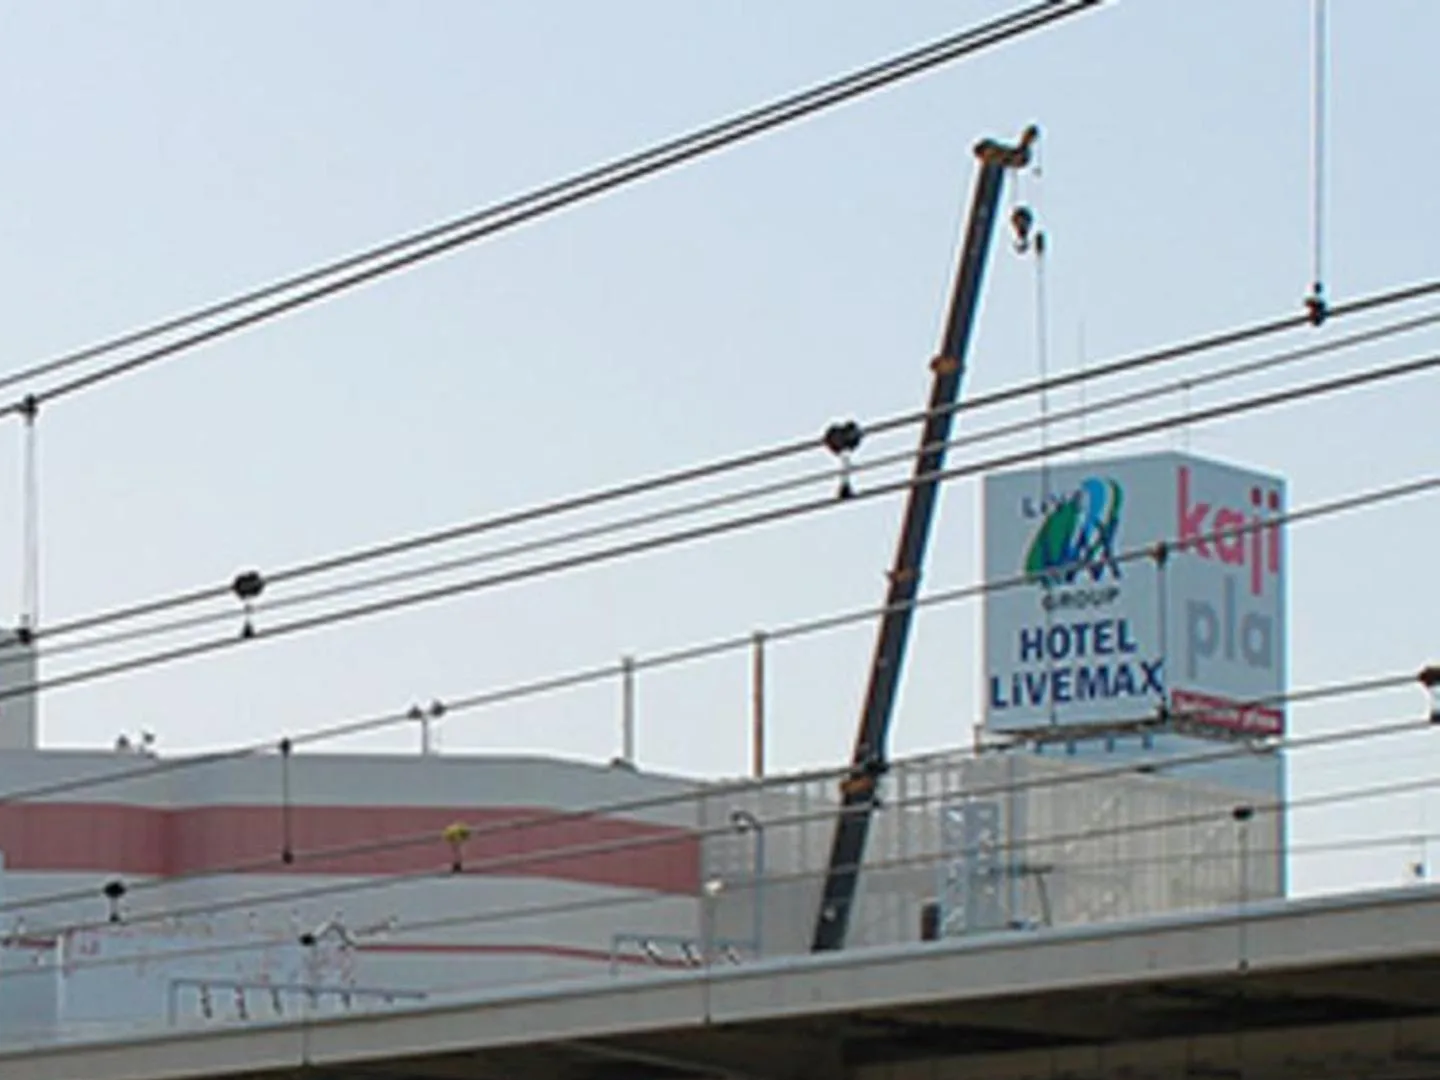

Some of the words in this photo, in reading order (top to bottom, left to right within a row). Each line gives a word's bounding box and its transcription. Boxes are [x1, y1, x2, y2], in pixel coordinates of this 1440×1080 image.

[1176, 465, 1280, 597] kaji
[1020, 618, 1137, 662] HOTEL
[1186, 573, 1274, 680] pla
